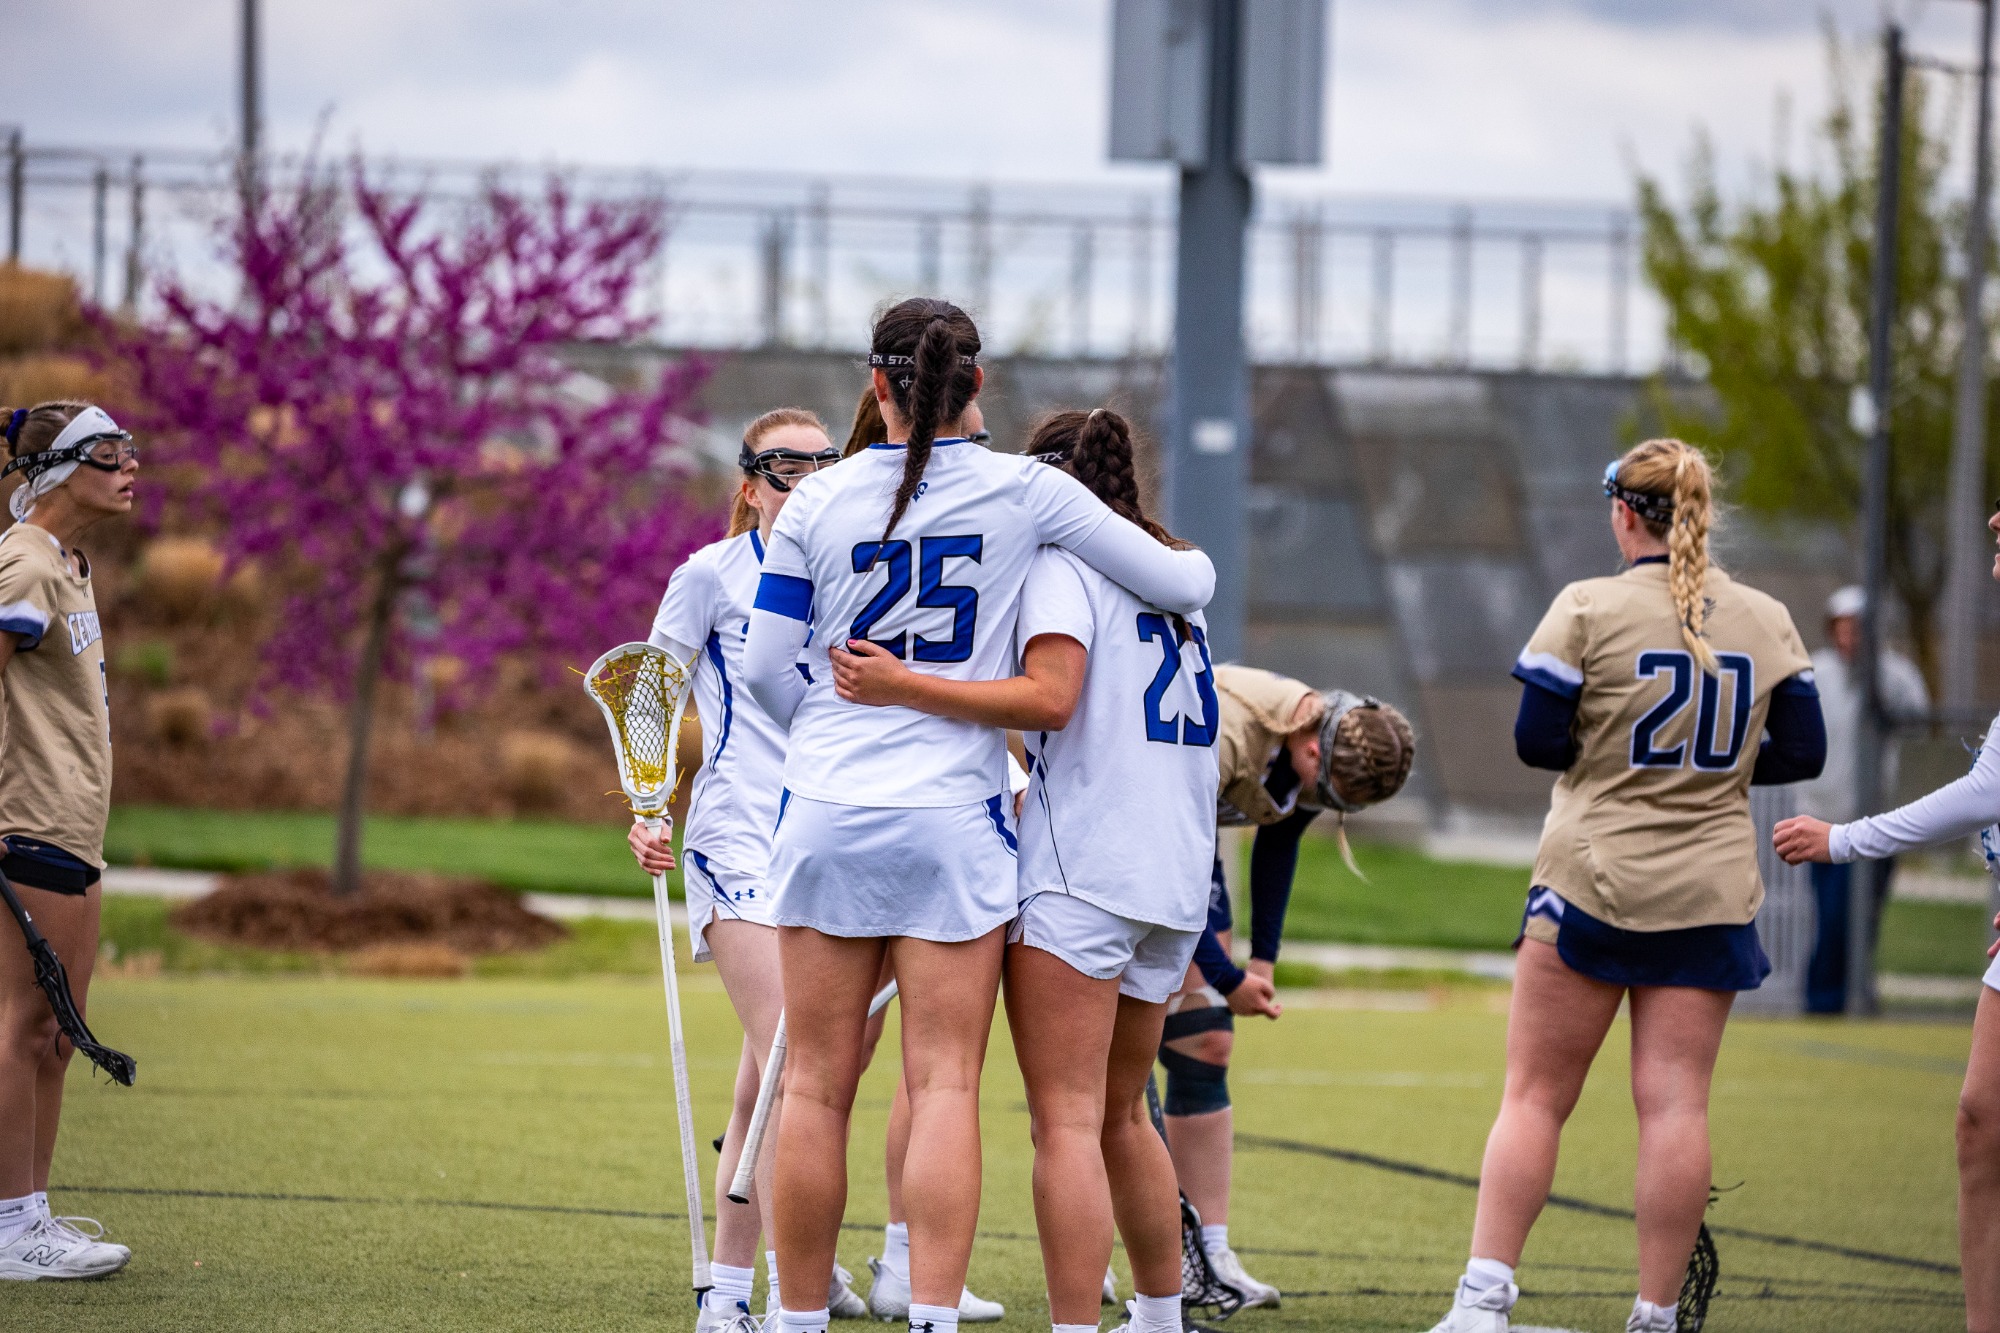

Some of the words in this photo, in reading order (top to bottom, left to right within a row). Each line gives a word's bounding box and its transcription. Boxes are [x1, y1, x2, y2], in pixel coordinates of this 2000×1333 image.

[872, 354, 884, 364] STX
[888, 355, 915, 365] STX
[16, 455, 31, 467] STX
[37, 450, 64, 462] STX
[27, 463, 45, 479] STX
[846, 534, 984, 663] 25
[1136, 612, 1220, 747] 23
[1630, 649, 1755, 773] 20
